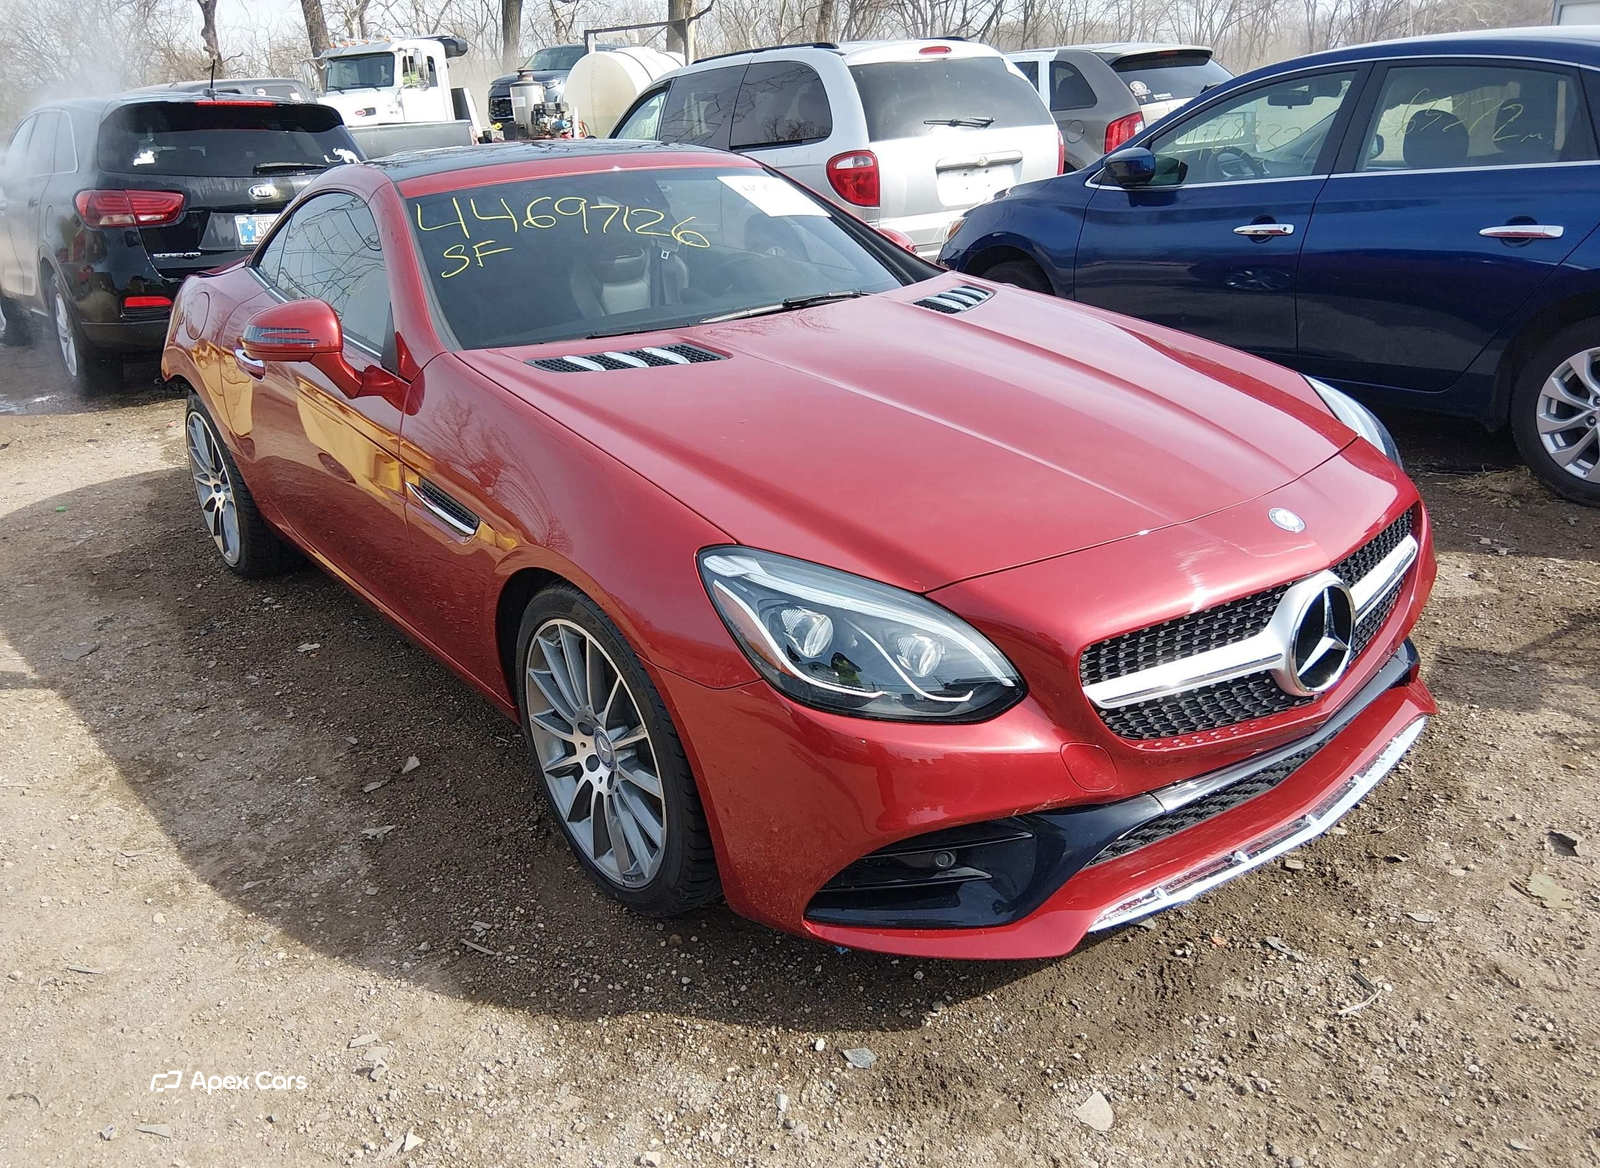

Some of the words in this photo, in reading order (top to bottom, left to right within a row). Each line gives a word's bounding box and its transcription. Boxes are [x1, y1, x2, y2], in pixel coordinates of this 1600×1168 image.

[415, 196, 711, 249] 44697126
[153, 251, 202, 259] SORENTO
[441, 239, 514, 279] SF
